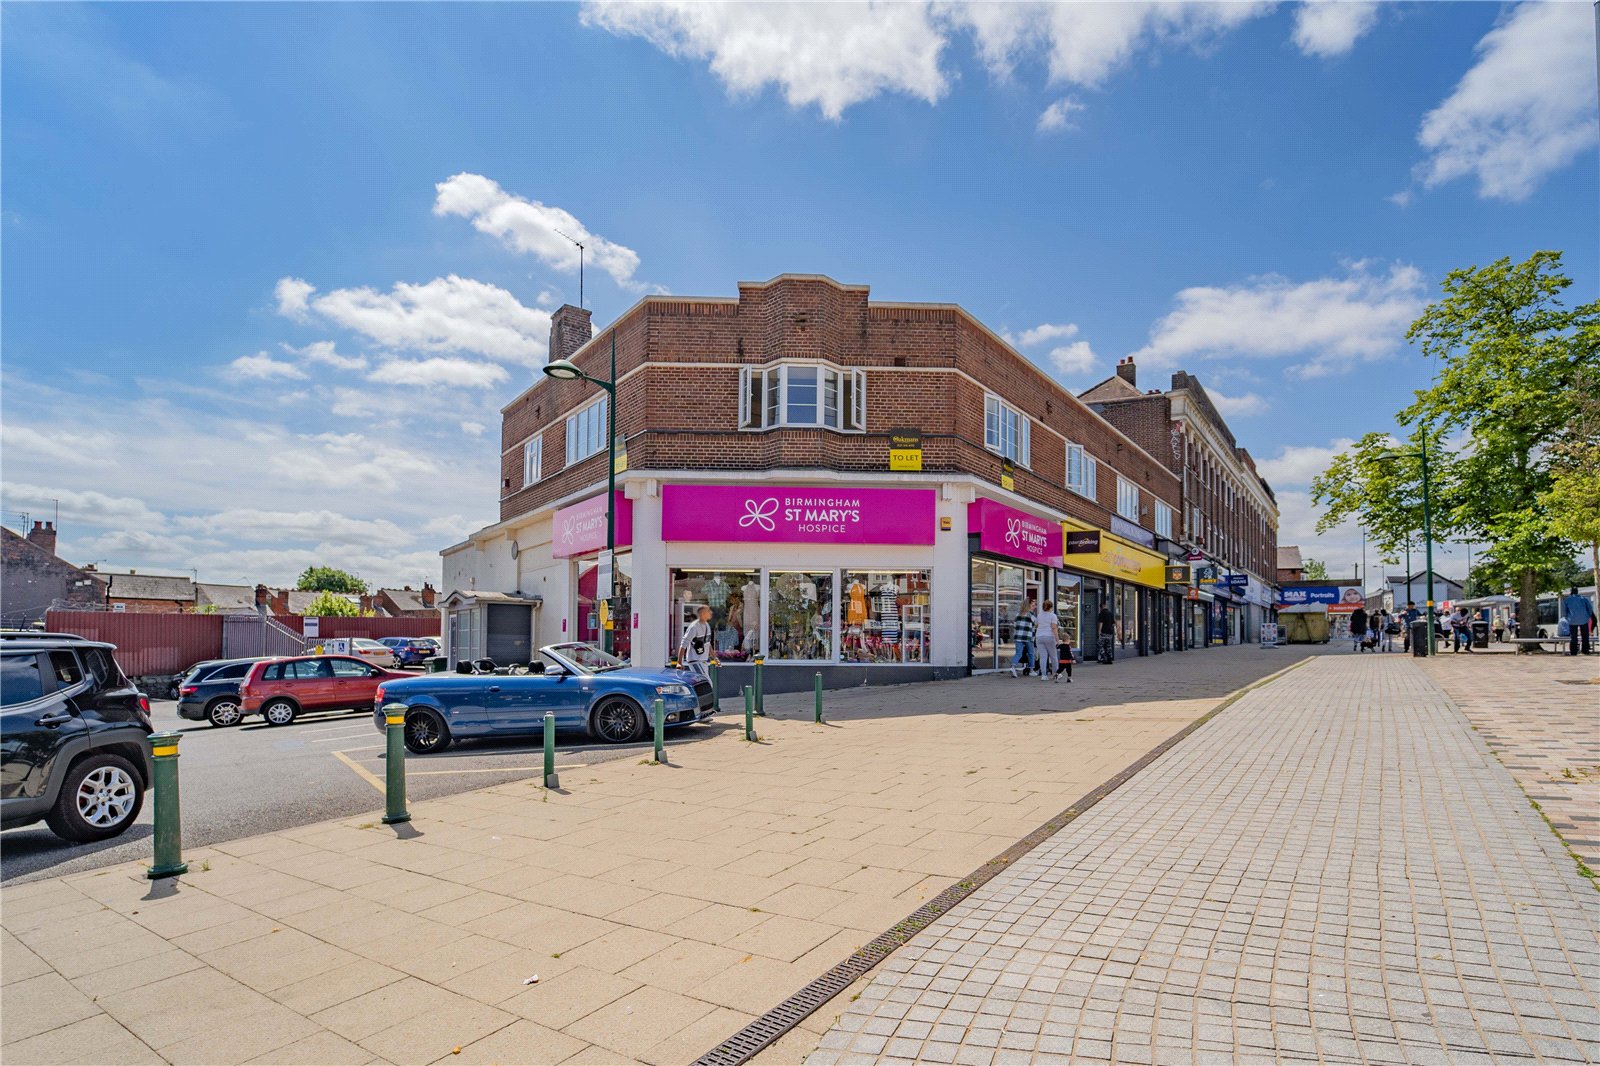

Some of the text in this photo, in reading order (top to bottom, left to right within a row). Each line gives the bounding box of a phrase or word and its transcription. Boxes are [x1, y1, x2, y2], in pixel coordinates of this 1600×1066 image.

[785, 498, 860, 507] BIRMINGHAM
[785, 509, 860, 522] ST MARY'S
[798, 524, 846, 533] HOSPICE
[1021, 520, 1047, 535] BIRMINGHAM
[1021, 530, 1047, 547] ST MARY'S
[1026, 545, 1043, 555] HOSPICE
